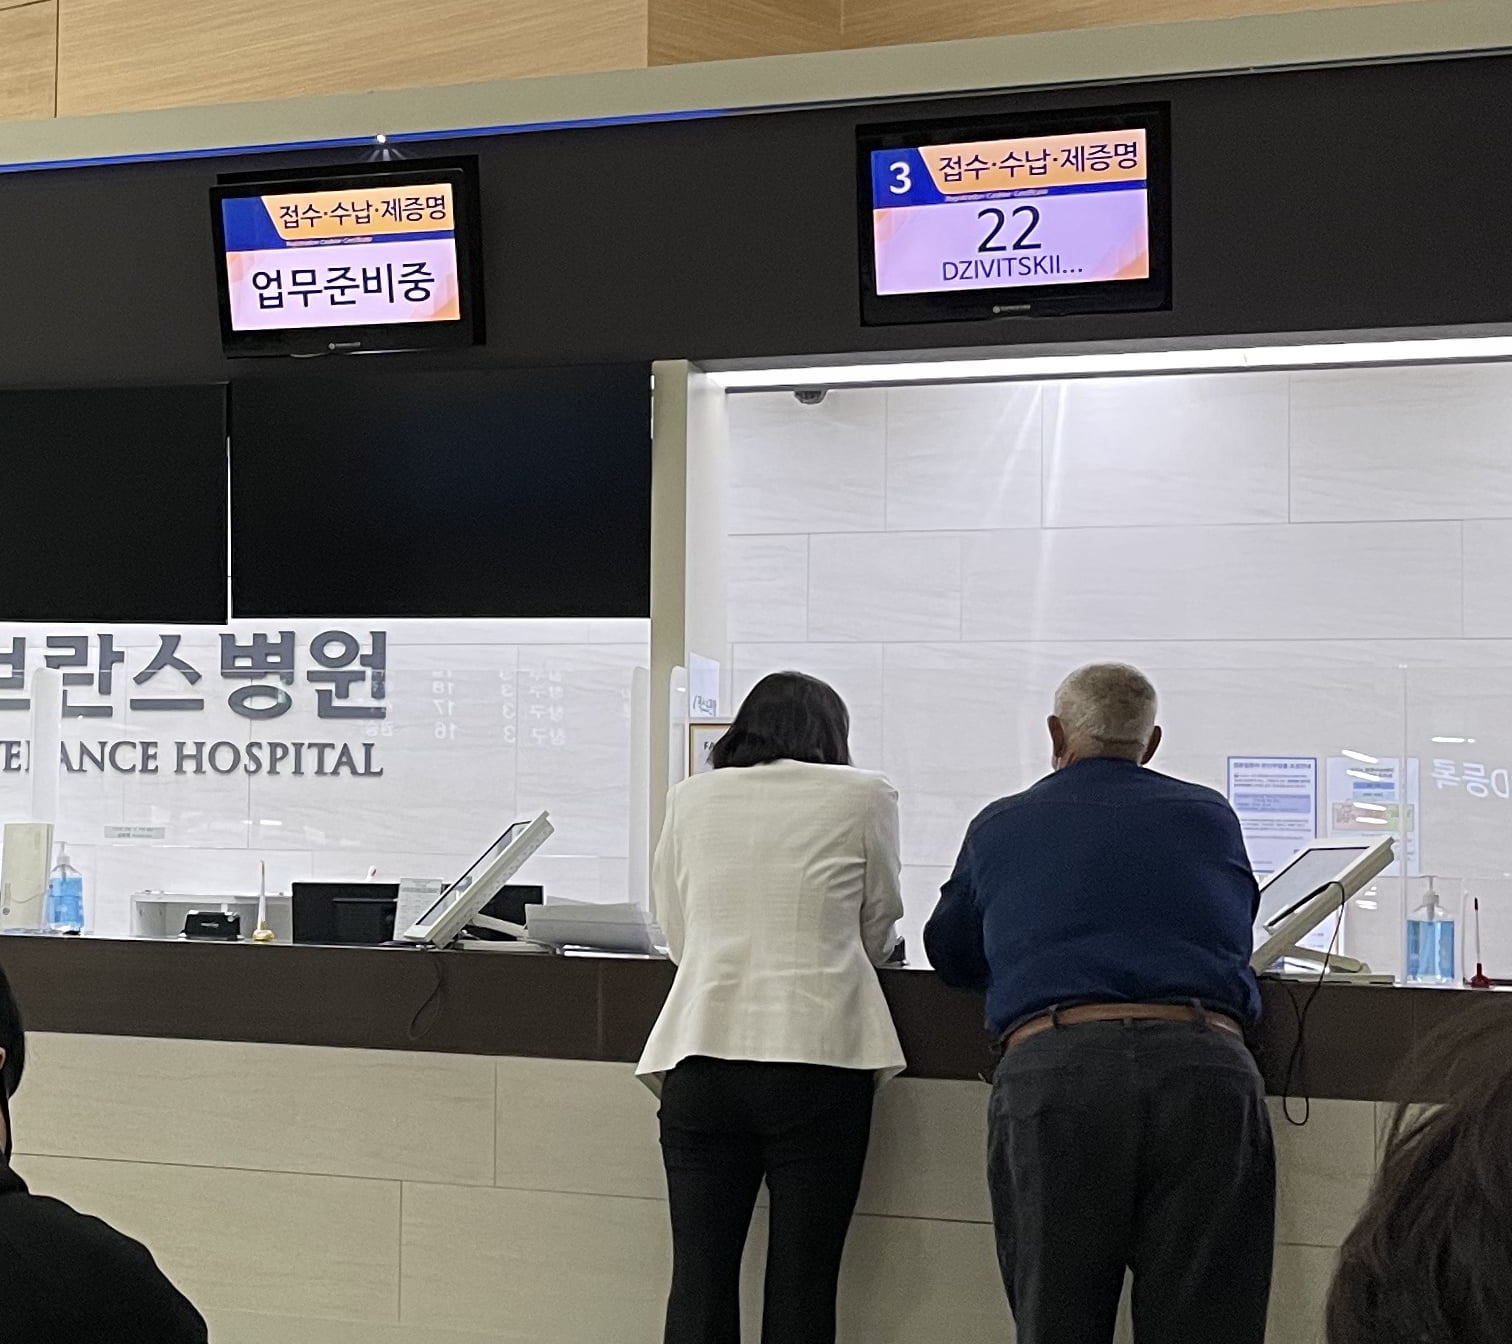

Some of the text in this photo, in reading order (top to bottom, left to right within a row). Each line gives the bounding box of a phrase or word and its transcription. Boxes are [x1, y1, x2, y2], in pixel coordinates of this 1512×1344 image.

[888, 161, 912, 195] 3
[976, 205, 1043, 254] 22
[251, 261, 436, 310] 업무준비중
[174, 740, 384, 777] HOSPITAL
